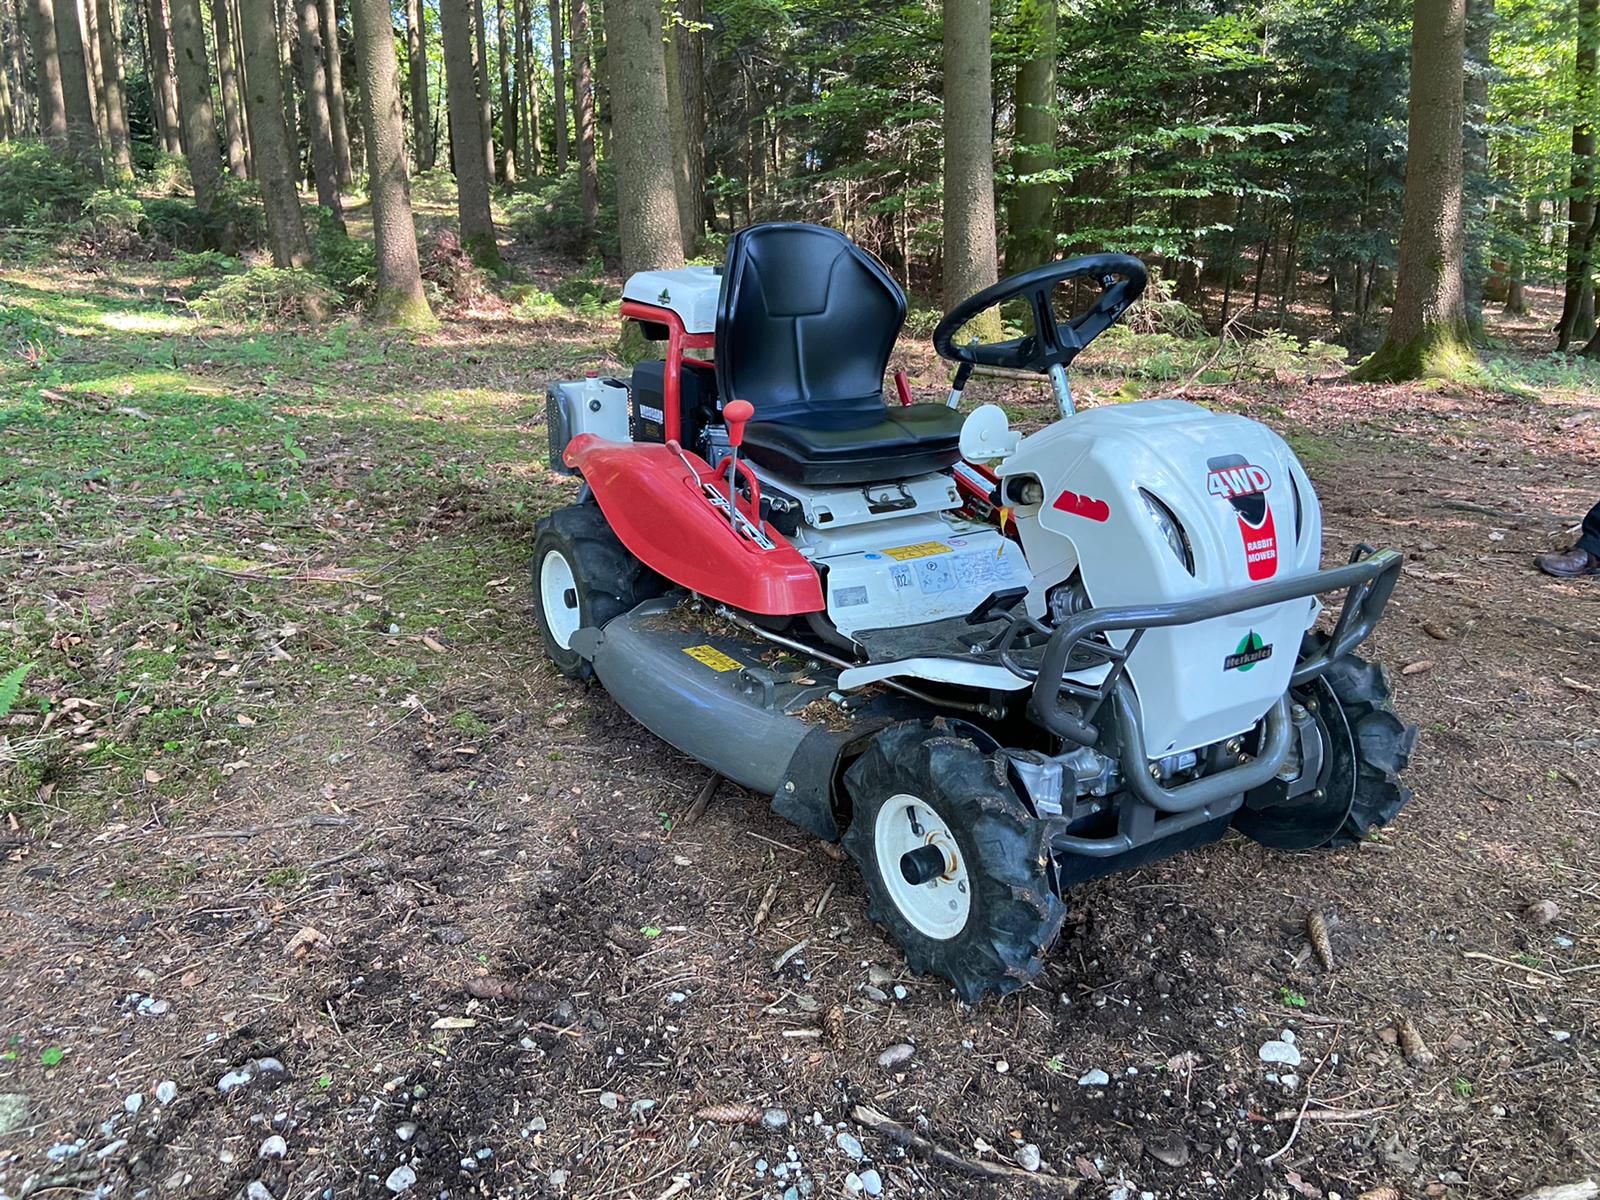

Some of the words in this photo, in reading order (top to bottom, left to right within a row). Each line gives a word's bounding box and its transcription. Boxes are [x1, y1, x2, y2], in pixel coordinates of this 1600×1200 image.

[1208, 466, 1271, 498] 4WD
[1247, 538, 1273, 551] RABBIT
[1248, 551, 1275, 563] MOWER
